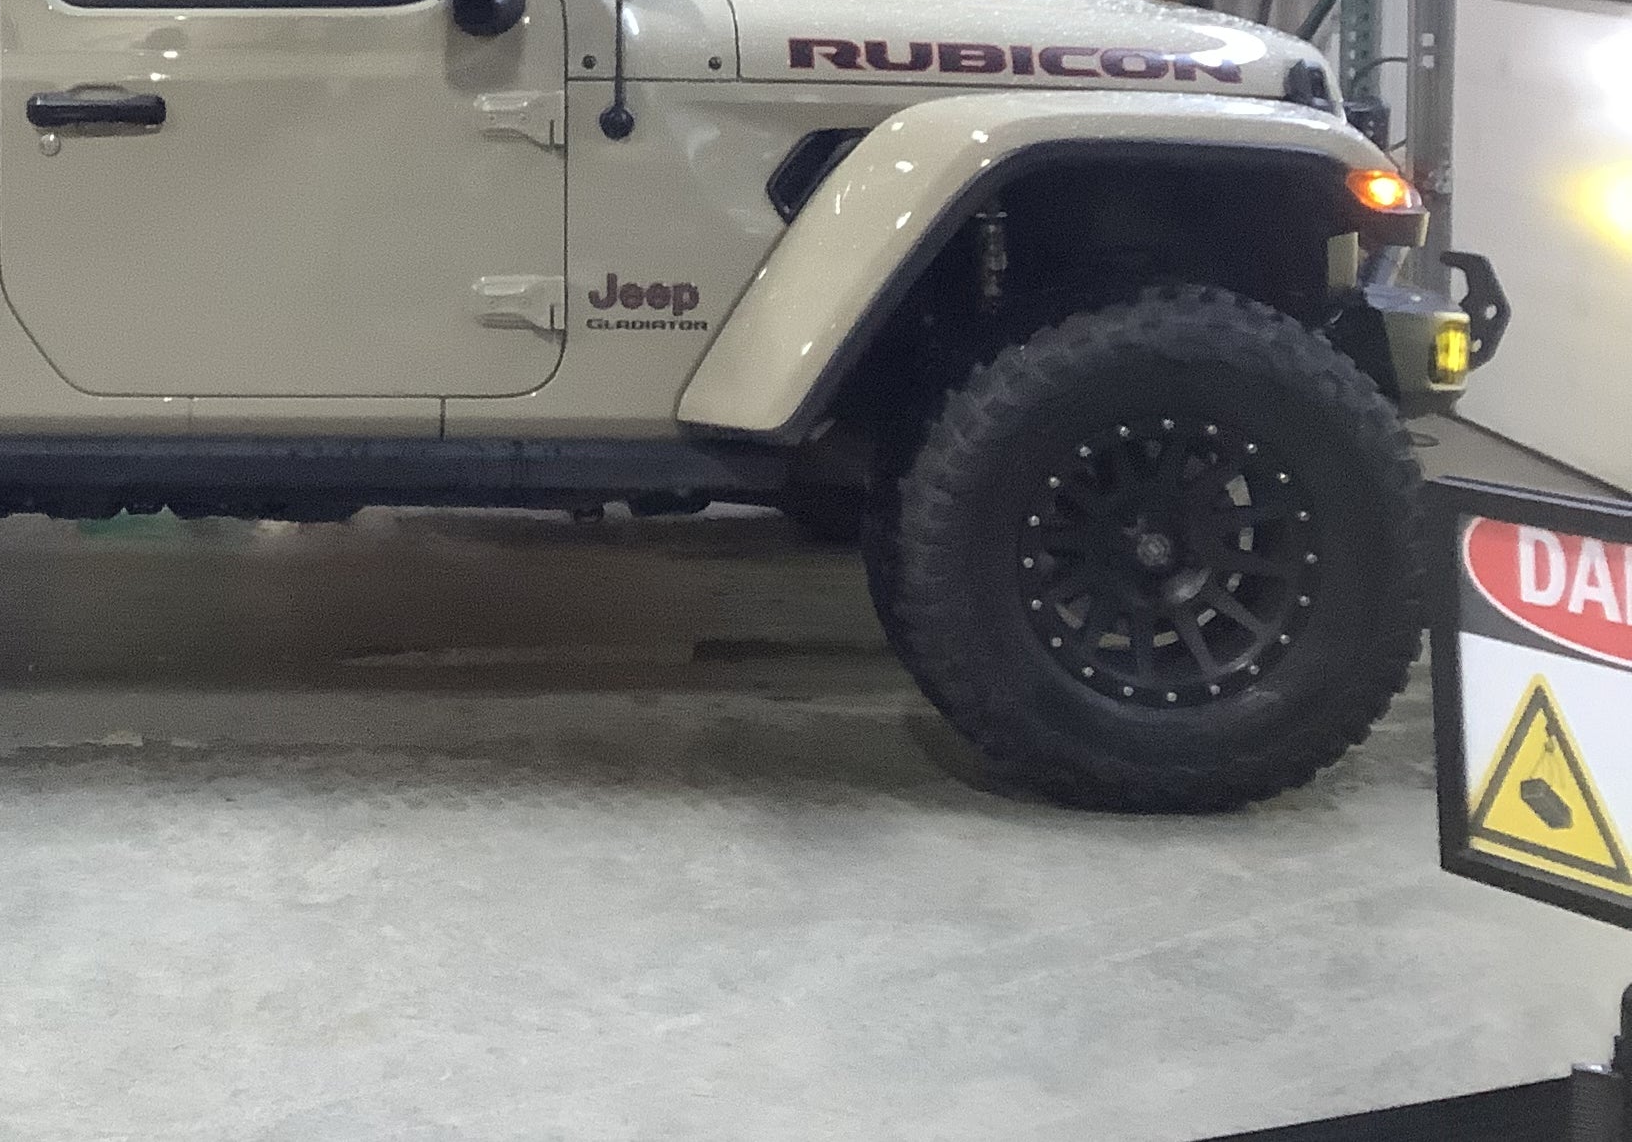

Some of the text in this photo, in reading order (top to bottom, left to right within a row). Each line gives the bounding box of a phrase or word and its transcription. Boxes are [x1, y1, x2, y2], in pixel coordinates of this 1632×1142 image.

[787, 37, 1244, 84] RUBICON
[588, 272, 700, 317] Jeep
[1519, 524, 1632, 626] DA
